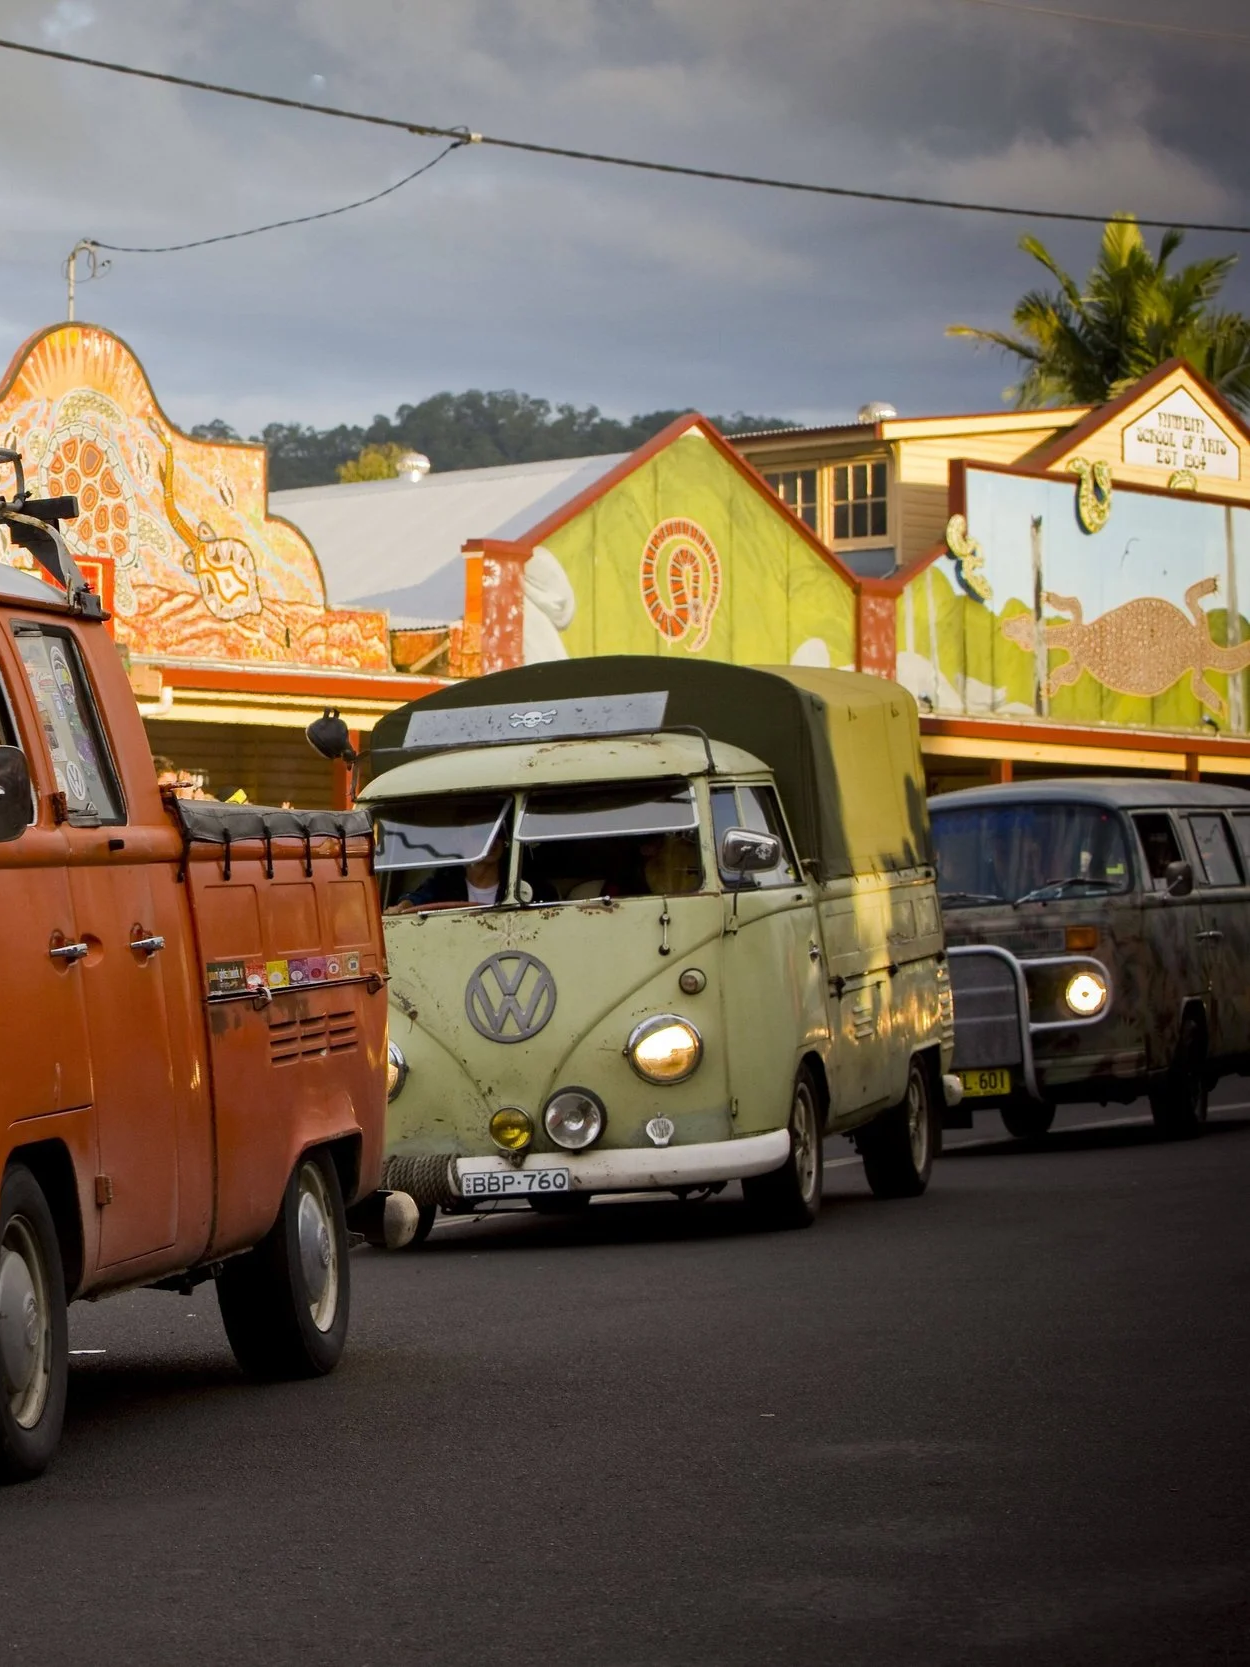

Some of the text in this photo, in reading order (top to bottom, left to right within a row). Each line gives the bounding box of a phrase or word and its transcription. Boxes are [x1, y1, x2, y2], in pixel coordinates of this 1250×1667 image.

[1137, 427, 1228, 456] SCHOOL OF ARTS
[1156, 448, 1178, 466] EST
[465, 950, 557, 1044] VW
